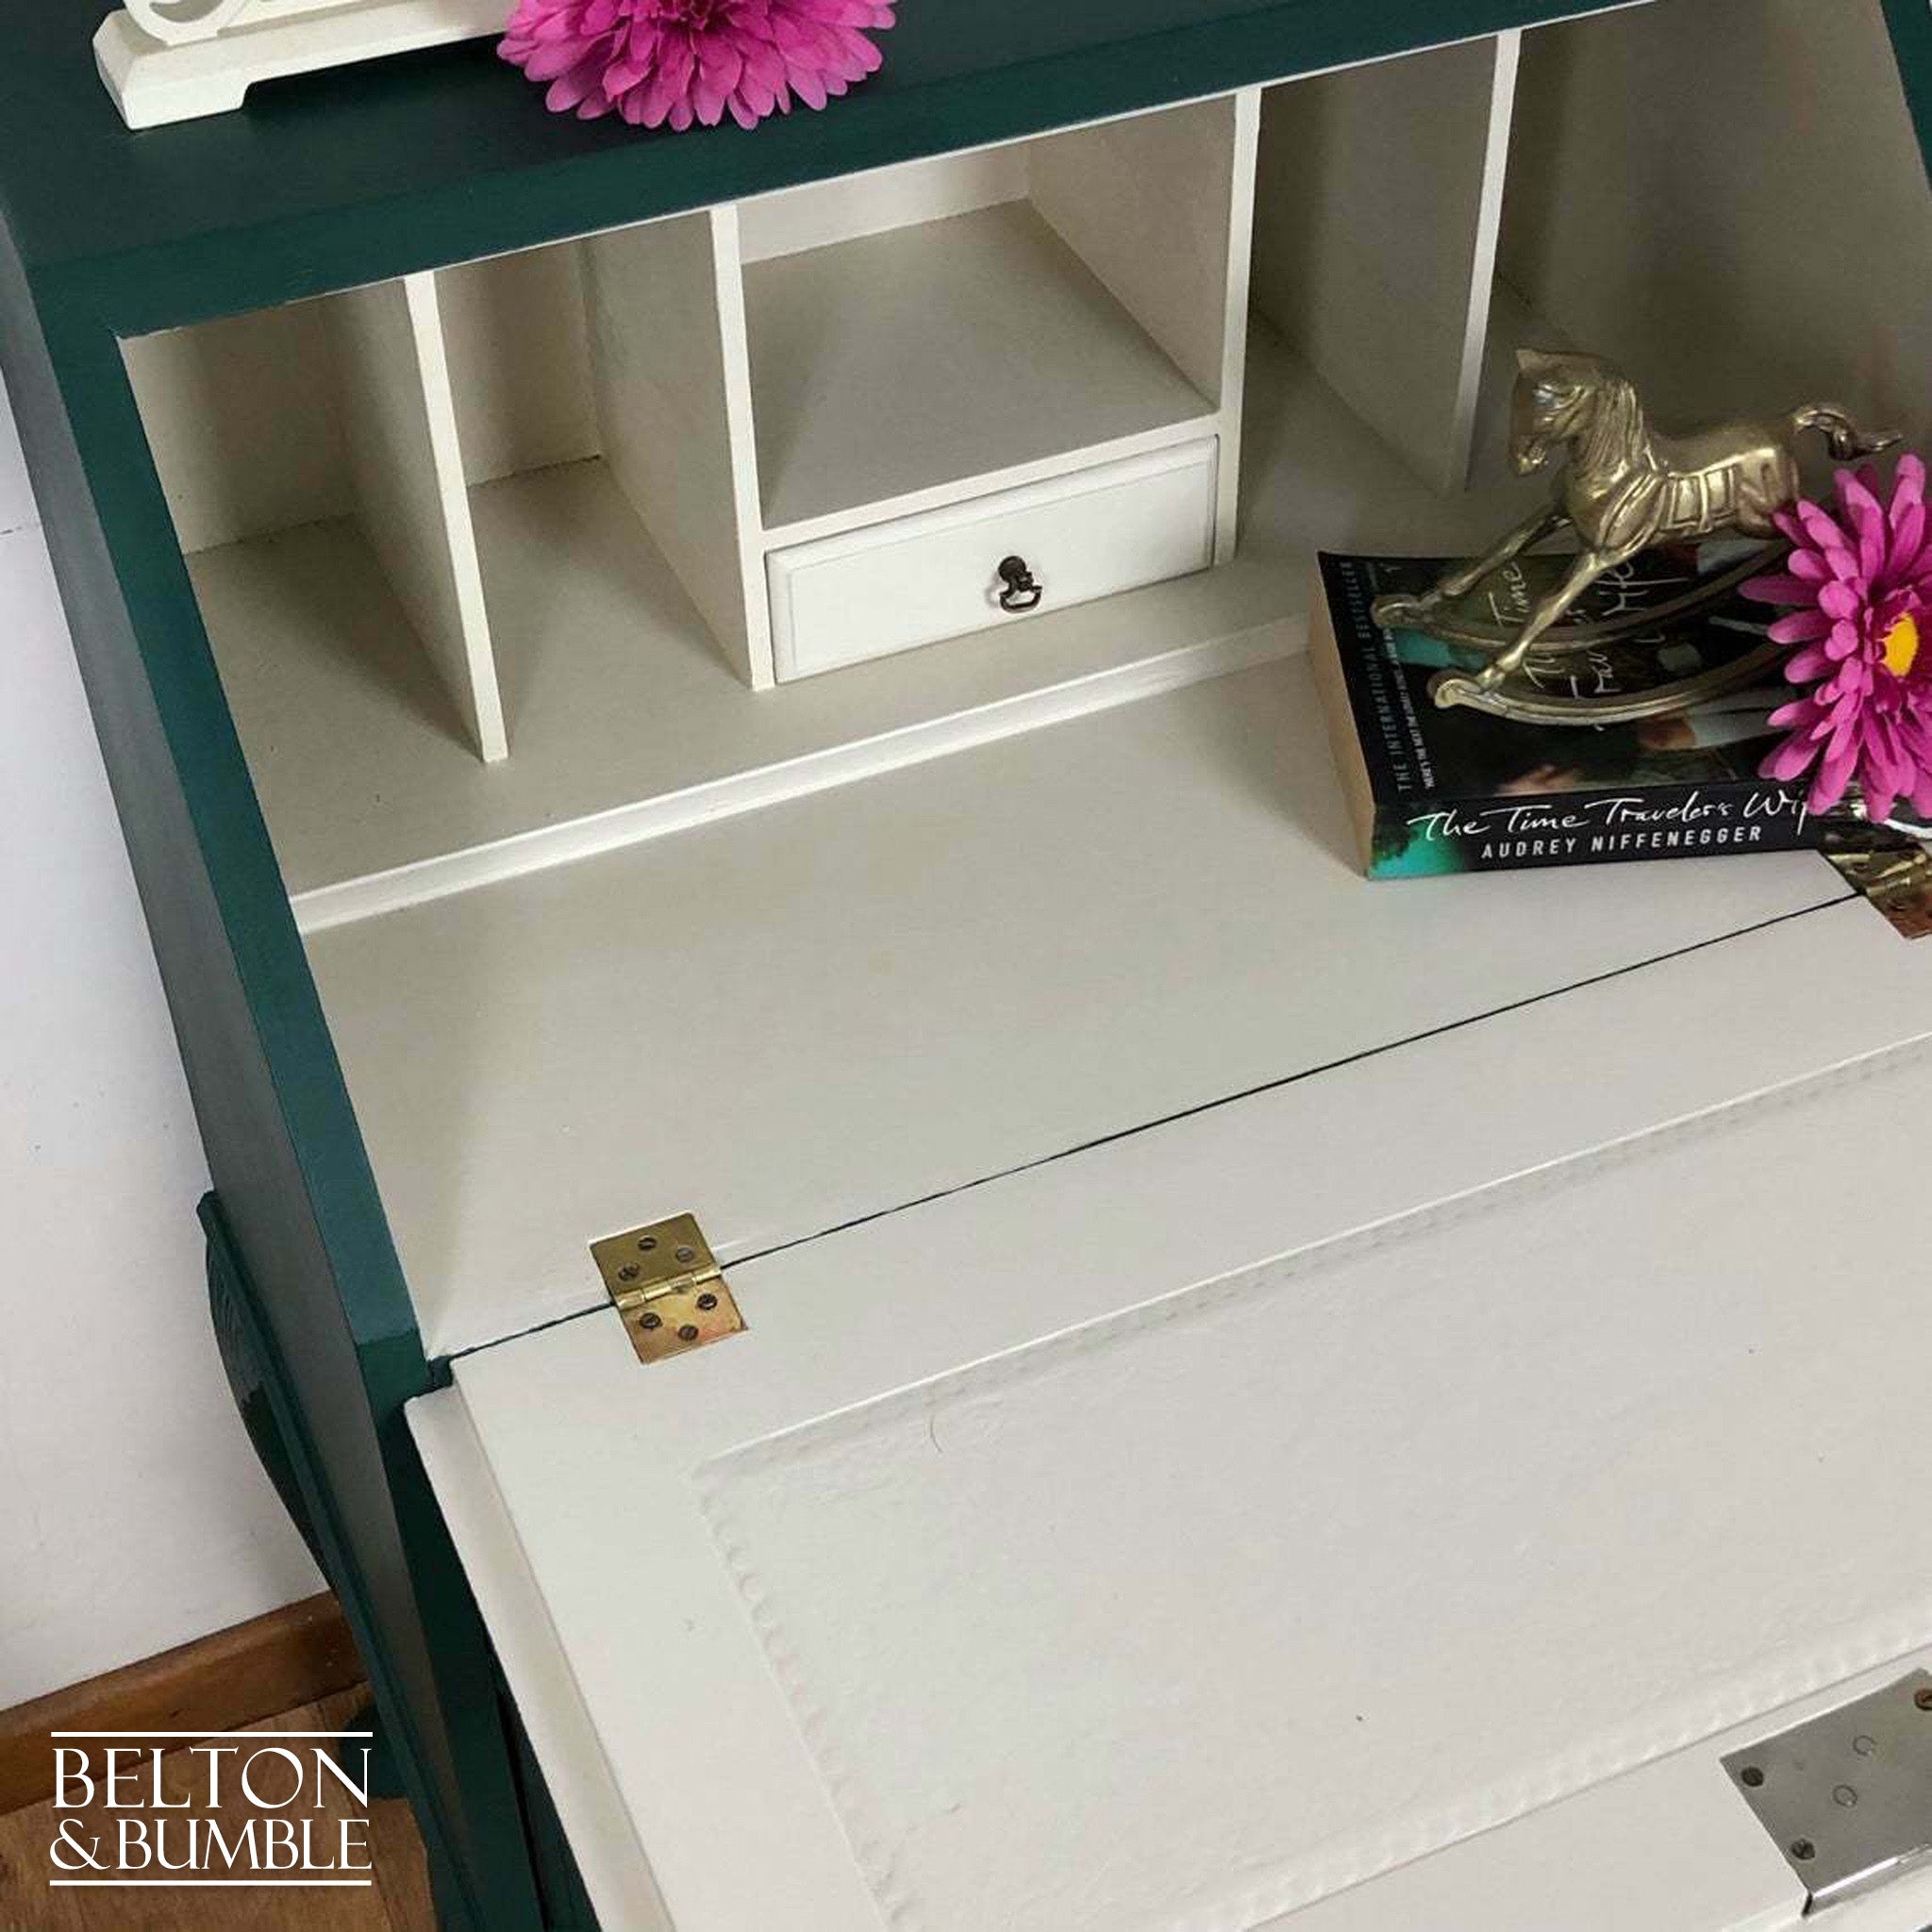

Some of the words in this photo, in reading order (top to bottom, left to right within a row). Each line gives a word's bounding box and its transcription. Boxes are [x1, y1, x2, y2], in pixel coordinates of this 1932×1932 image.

[1339, 561, 1373, 640] BESTSELLER
[1488, 561, 1532, 628] Time
[1522, 651, 1565, 690] Th
[1361, 646, 1404, 758] INTERNATIONAL
[1392, 760, 1413, 794] THE
[1406, 808, 1491, 841] The
[1479, 804, 1591, 834] Time
[1742, 789, 1809, 836] Wif
[1481, 837, 1578, 859] AUDREY
[1591, 825, 1762, 852] NIFFENEGGER
